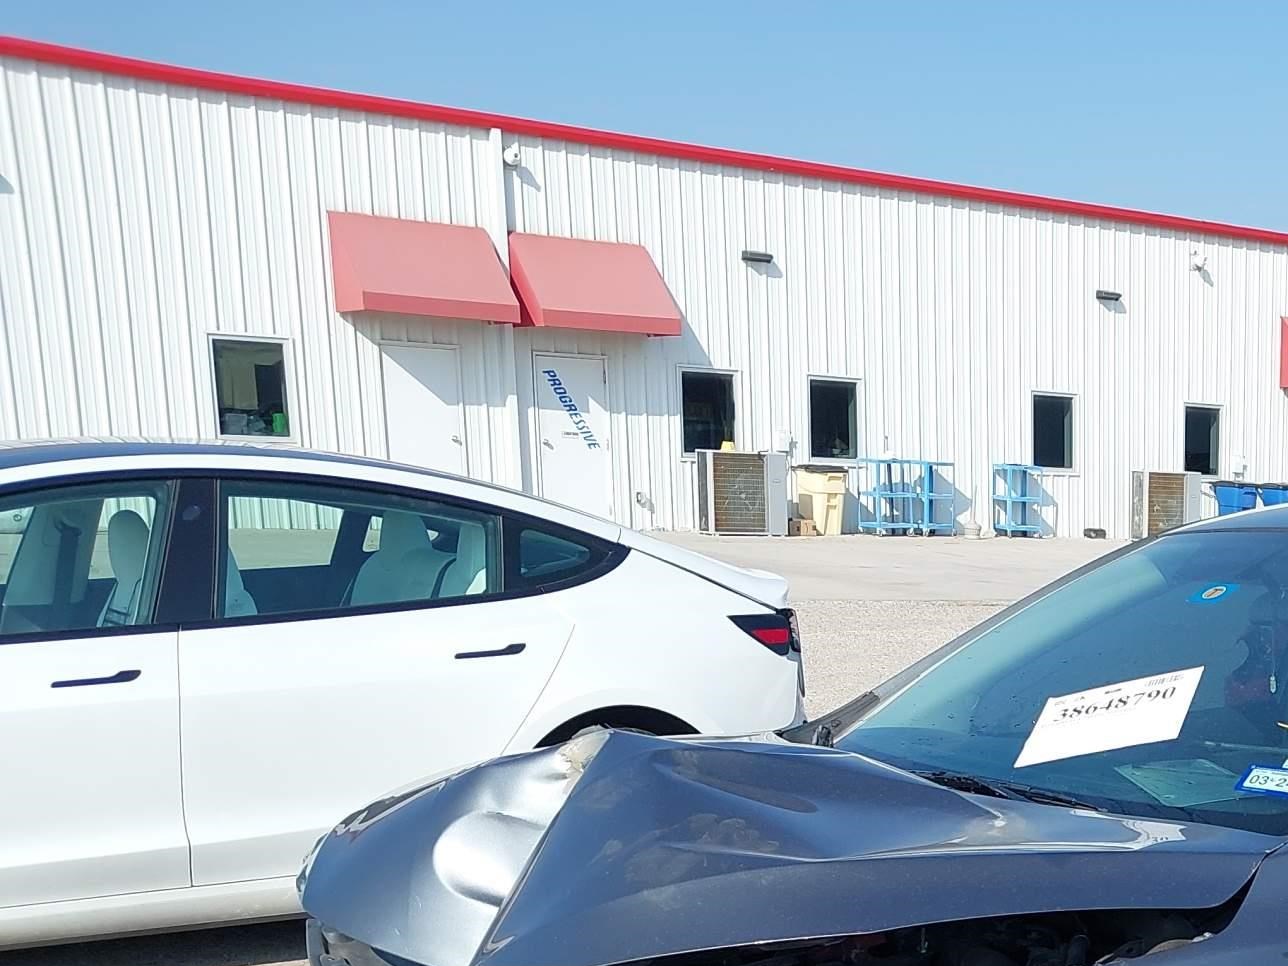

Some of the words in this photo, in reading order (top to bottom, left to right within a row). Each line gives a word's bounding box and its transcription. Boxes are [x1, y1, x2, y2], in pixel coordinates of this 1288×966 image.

[542, 369, 600, 449] PROGRESSIVE
[1052, 686, 1177, 722] 38648790
[1249, 774, 1270, 786] 03
